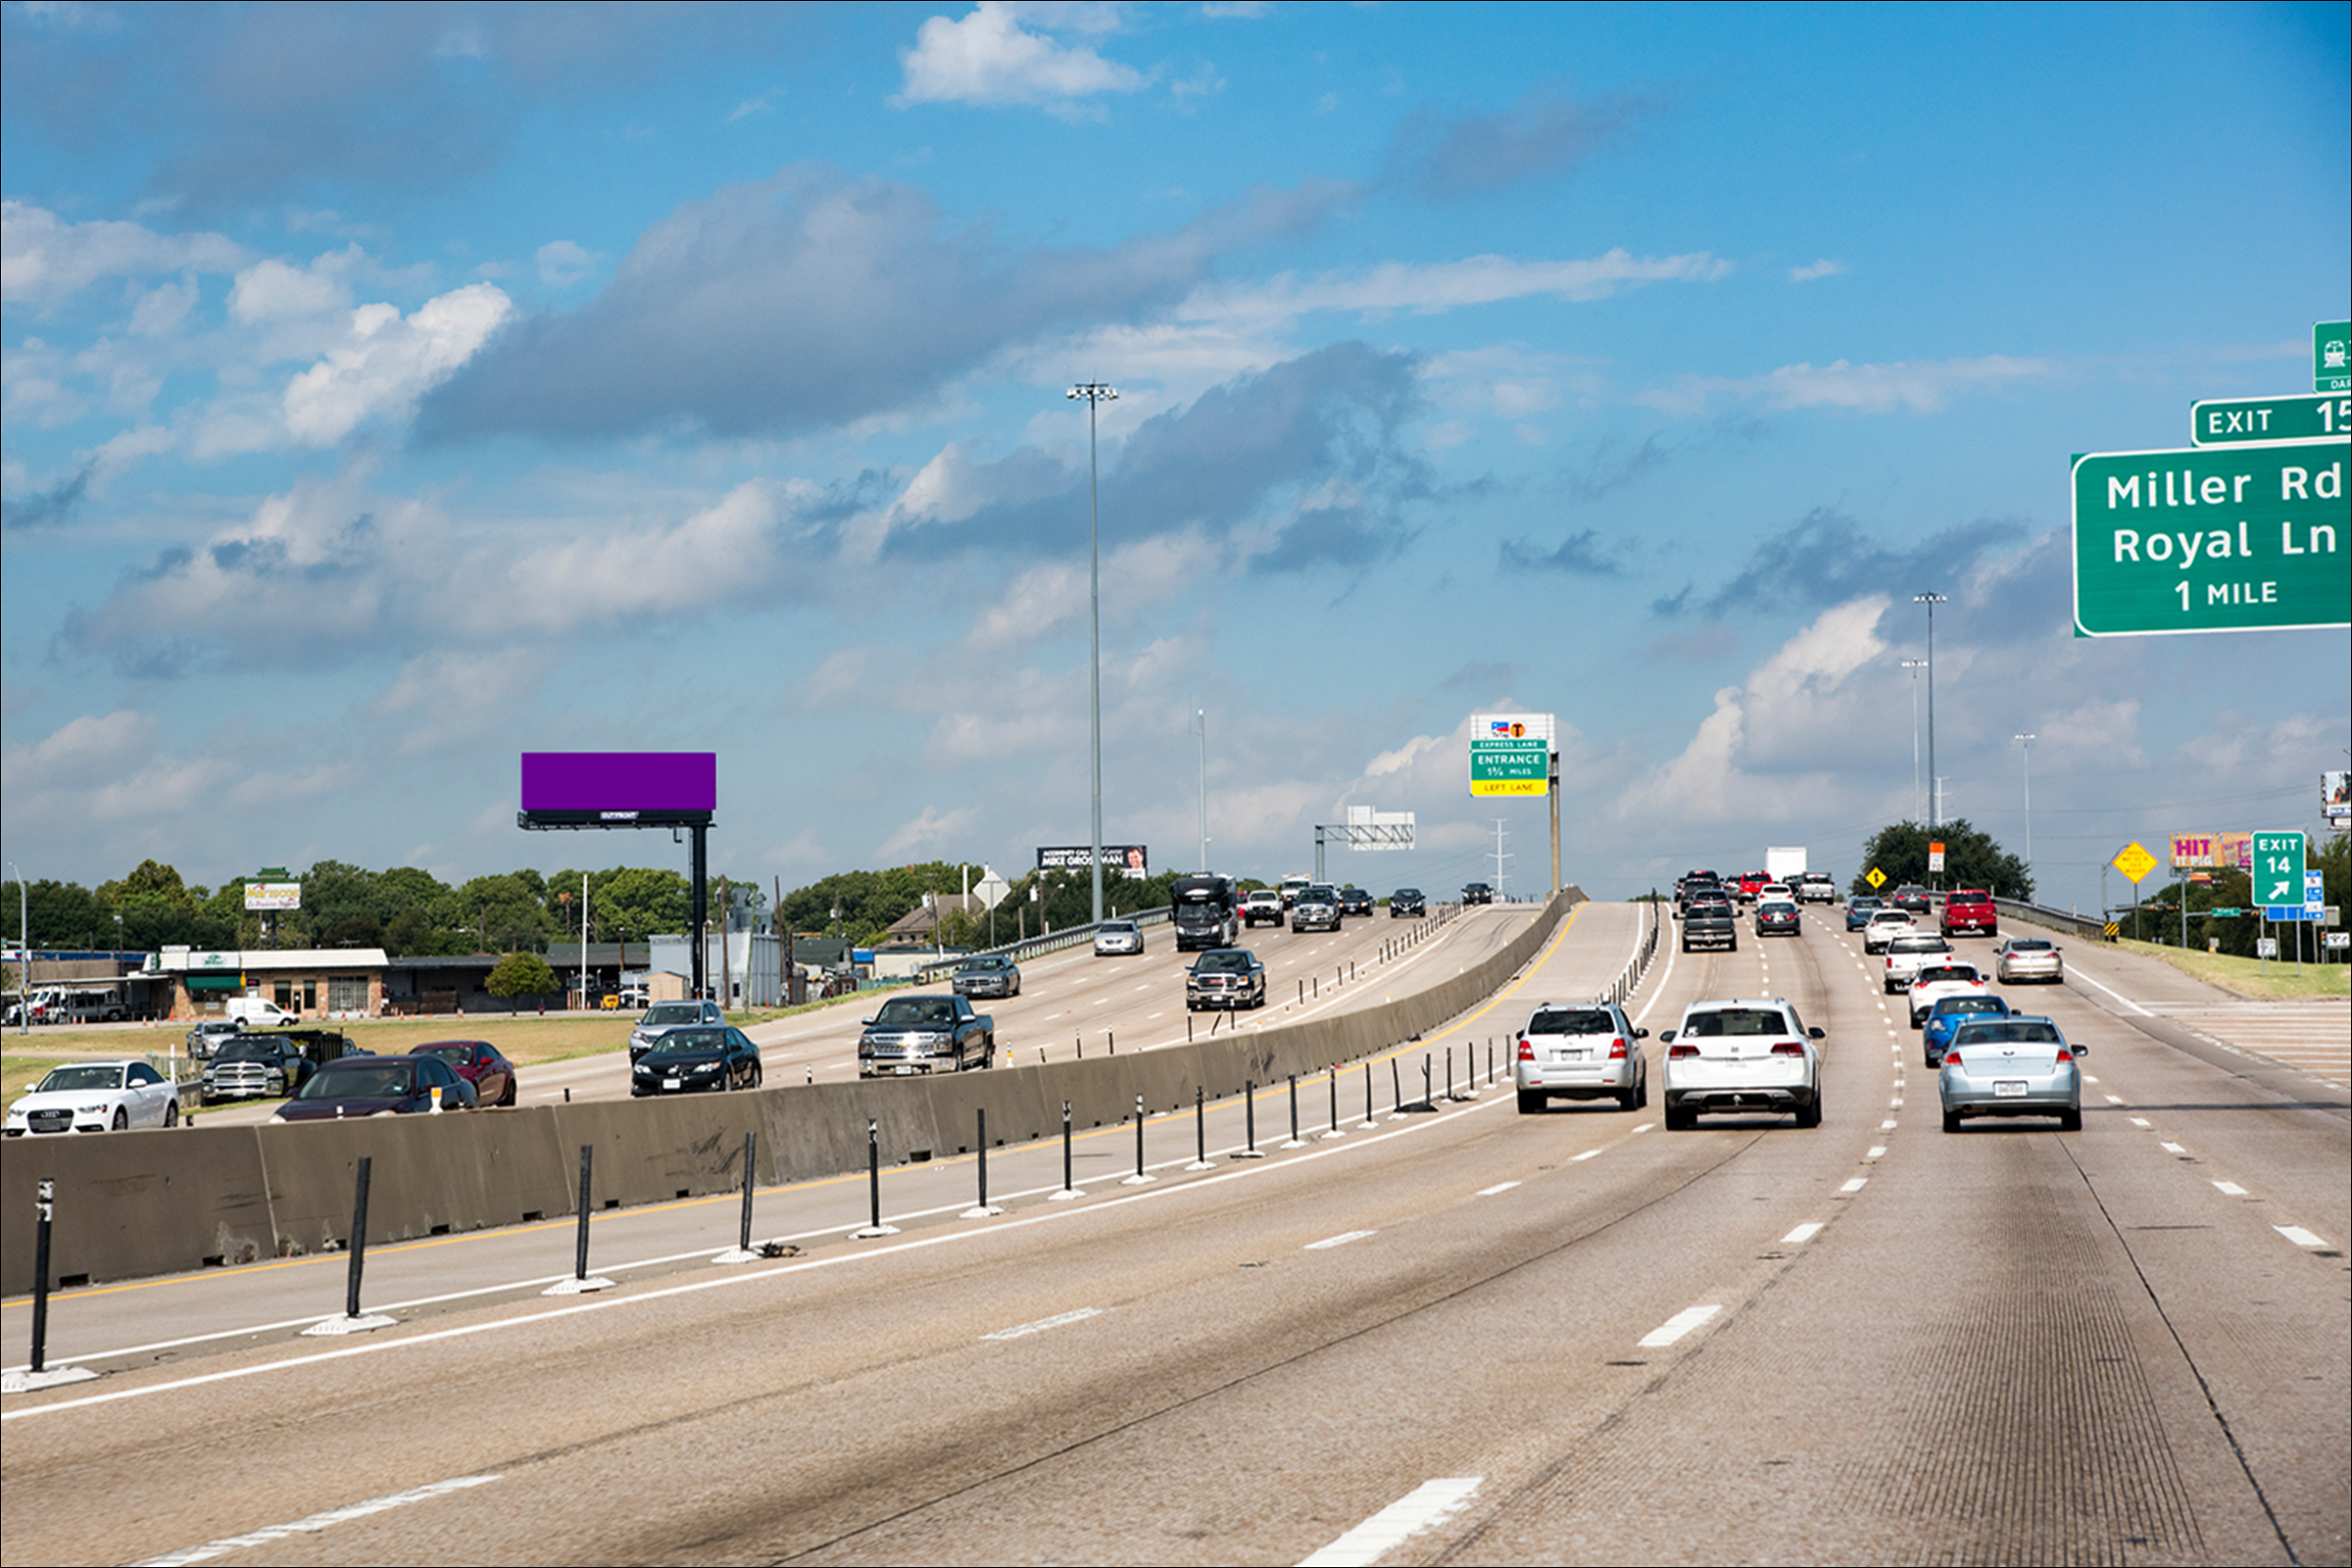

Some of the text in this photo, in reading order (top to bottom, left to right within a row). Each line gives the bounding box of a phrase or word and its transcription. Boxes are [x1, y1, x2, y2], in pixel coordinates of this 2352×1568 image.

[2209, 400, 2351, 433] EXIT 15
[2108, 462, 2341, 509] Miller Rd
[2114, 521, 2336, 569] Royal Ln
[2175, 580, 2278, 612] 1 MILE
[1478, 755, 1540, 764] ENTRANCE
[2177, 839, 2210, 857] HIT
[2259, 838, 2298, 851] EXIT
[1042, 856, 1123, 866] MIKE GROSMAN
[2176, 856, 2212, 866] IT BIG
[2267, 856, 2291, 874] 14
[246, 887, 300, 899] Mariscos
